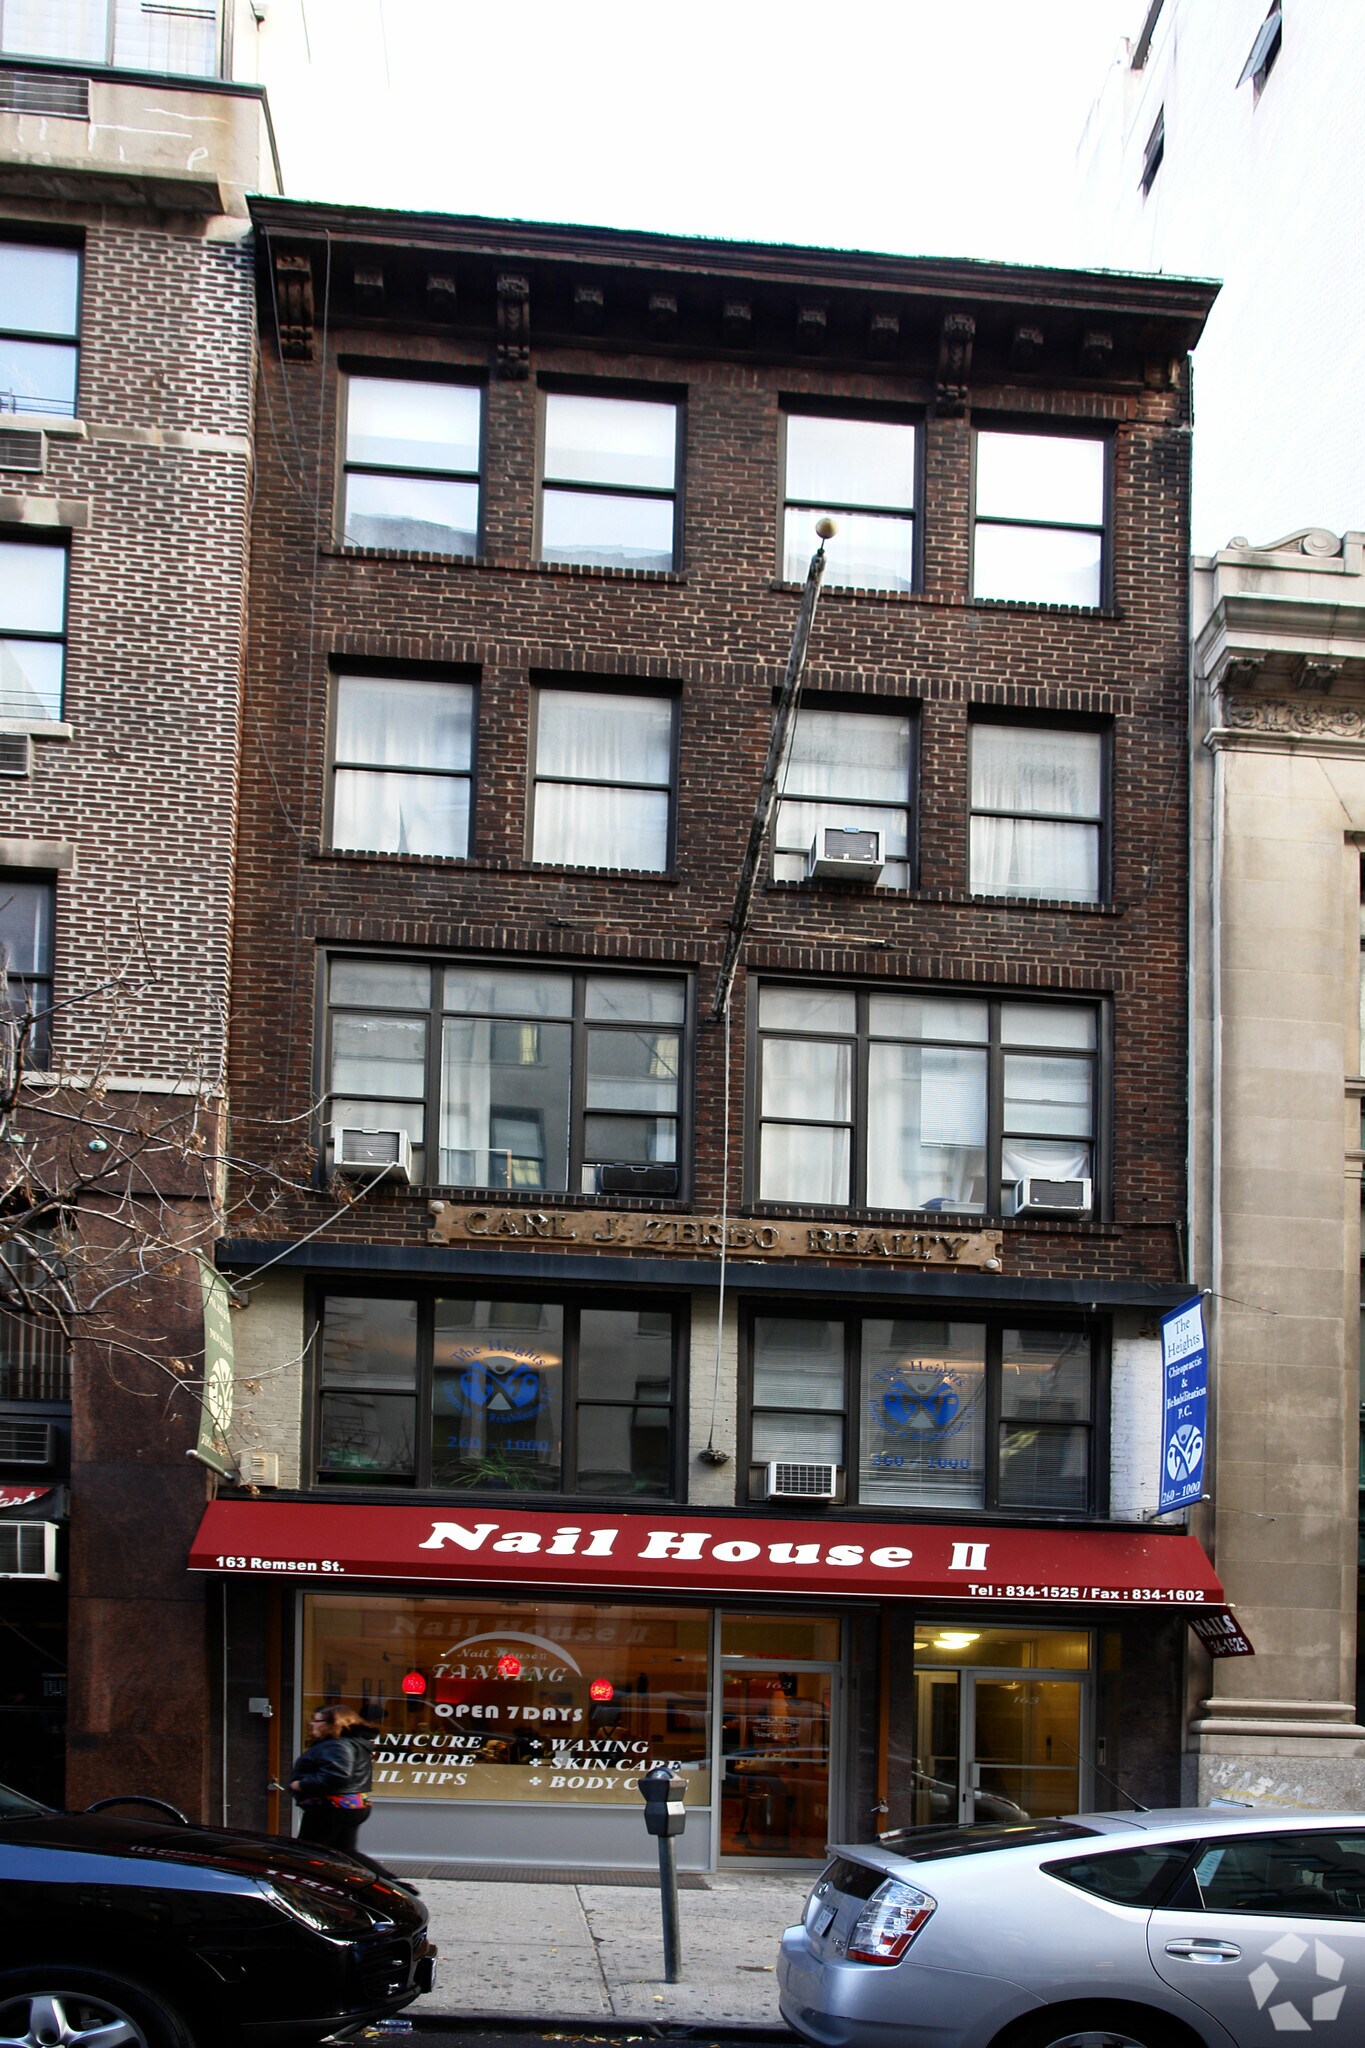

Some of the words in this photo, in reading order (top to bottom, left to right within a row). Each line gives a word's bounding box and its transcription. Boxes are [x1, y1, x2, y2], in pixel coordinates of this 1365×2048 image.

[464, 1211, 576, 1239] CARL
[643, 1219, 780, 1250] ZERBO
[807, 1228, 970, 1260] REALTY
[1174, 1318, 1190, 1335] The
[451, 1345, 481, 1363] The
[488, 1339, 546, 1366] Heights
[1168, 1334, 1200, 1358] Heights
[1168, 1356, 1202, 1378] Chiropractic
[1181, 1378, 1188, 1388] &
[1166, 1387, 1206, 1409] Rehabilitation
[1178, 1405, 1192, 1419] P.C.
[448, 1436, 481, 1448] 260
[506, 1438, 549, 1451] 1000
[1162, 1488, 1174, 1504] 260
[1182, 1480, 1200, 1498] 1000
[419, 1522, 618, 1556] Nail
[637, 1531, 913, 1568] House
[948, 1542, 990, 1570] II
[216, 1556, 246, 1568] 163
[251, 1557, 317, 1571] Remsen
[321, 1560, 344, 1572] St.
[1006, 1585, 1079, 1598] 834-1525
[1132, 1589, 1204, 1601] 834-1602
[1191, 1614, 1236, 1637] NAILS
[457, 1648, 490, 1659] Nail
[496, 1647, 538, 1661] House
[432, 1663, 568, 1683] TANNING
[766, 1681, 793, 1690] 163
[434, 1703, 499, 1719] OPEN
[371, 1733, 482, 1749] ANICURE
[551, 1738, 649, 1754] WAXING
[370, 1751, 476, 1767] DICURE
[550, 1757, 610, 1771] SKIN
[411, 1771, 468, 1786] TIPS
[549, 1775, 618, 1790] BODY
